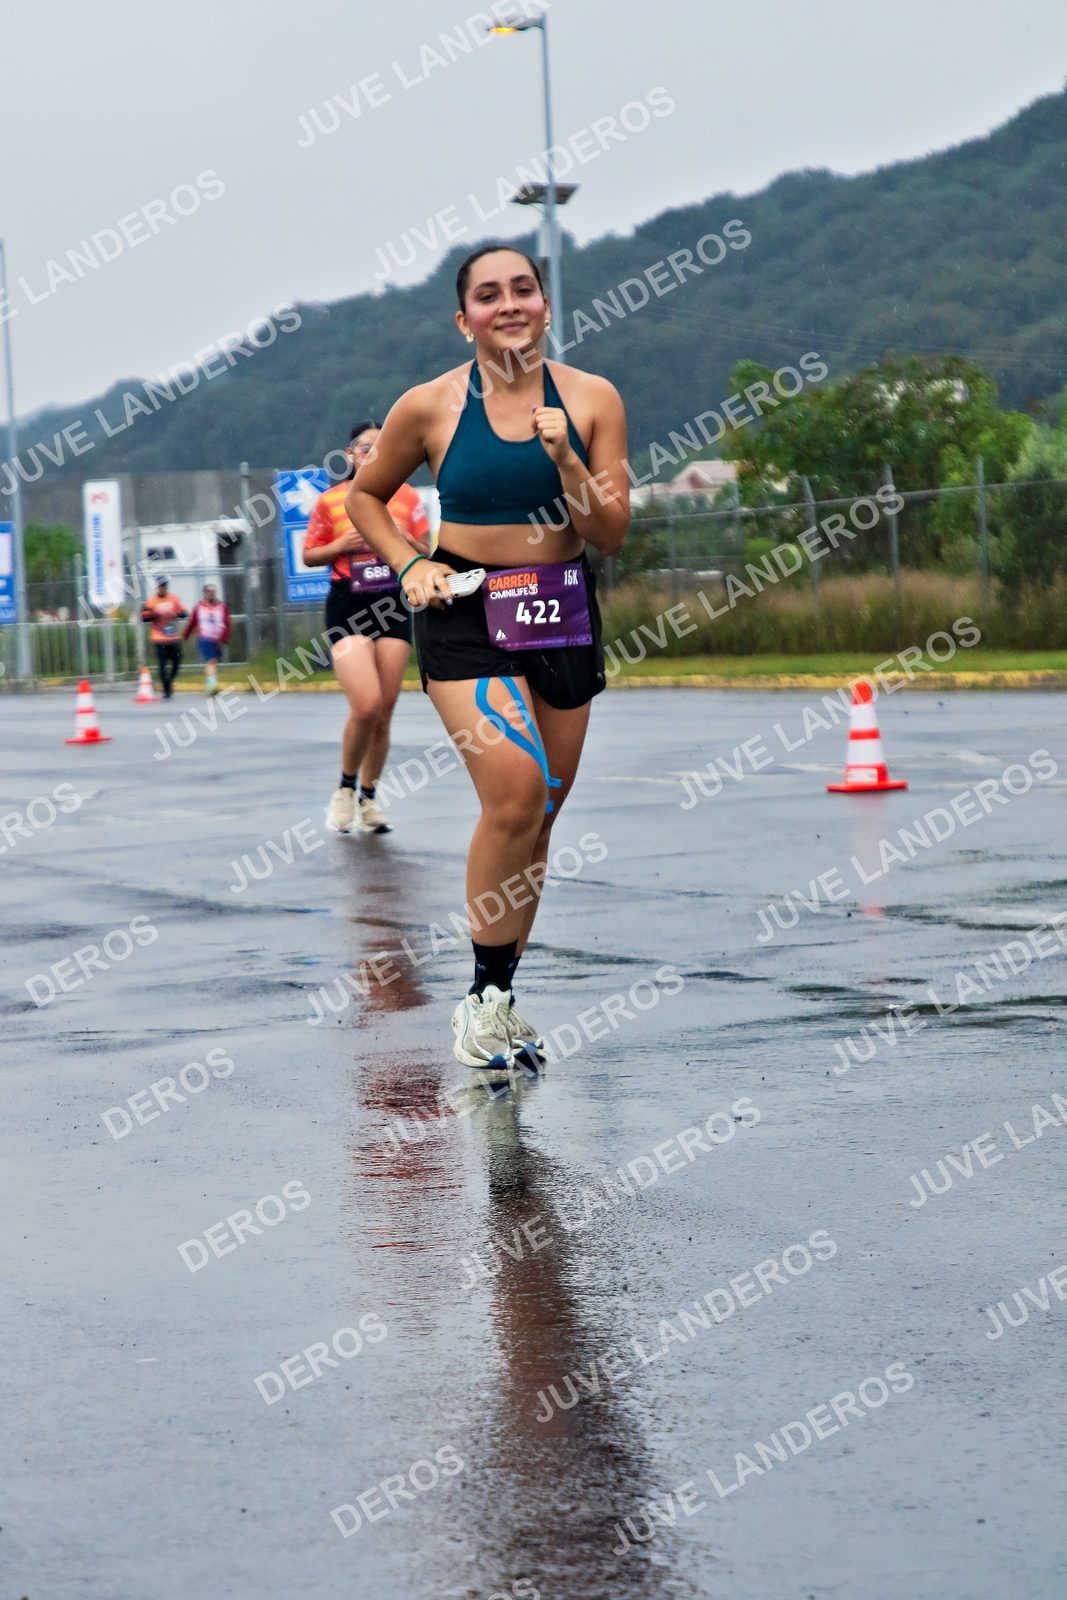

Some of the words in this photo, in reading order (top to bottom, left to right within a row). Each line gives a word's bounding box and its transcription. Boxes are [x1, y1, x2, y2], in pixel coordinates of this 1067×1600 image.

[488, 572, 539, 591] CARRERA
[564, 569, 578, 586] 15K
[490, 586, 528, 600] OMNILIFE
[516, 599, 561, 625] 422
